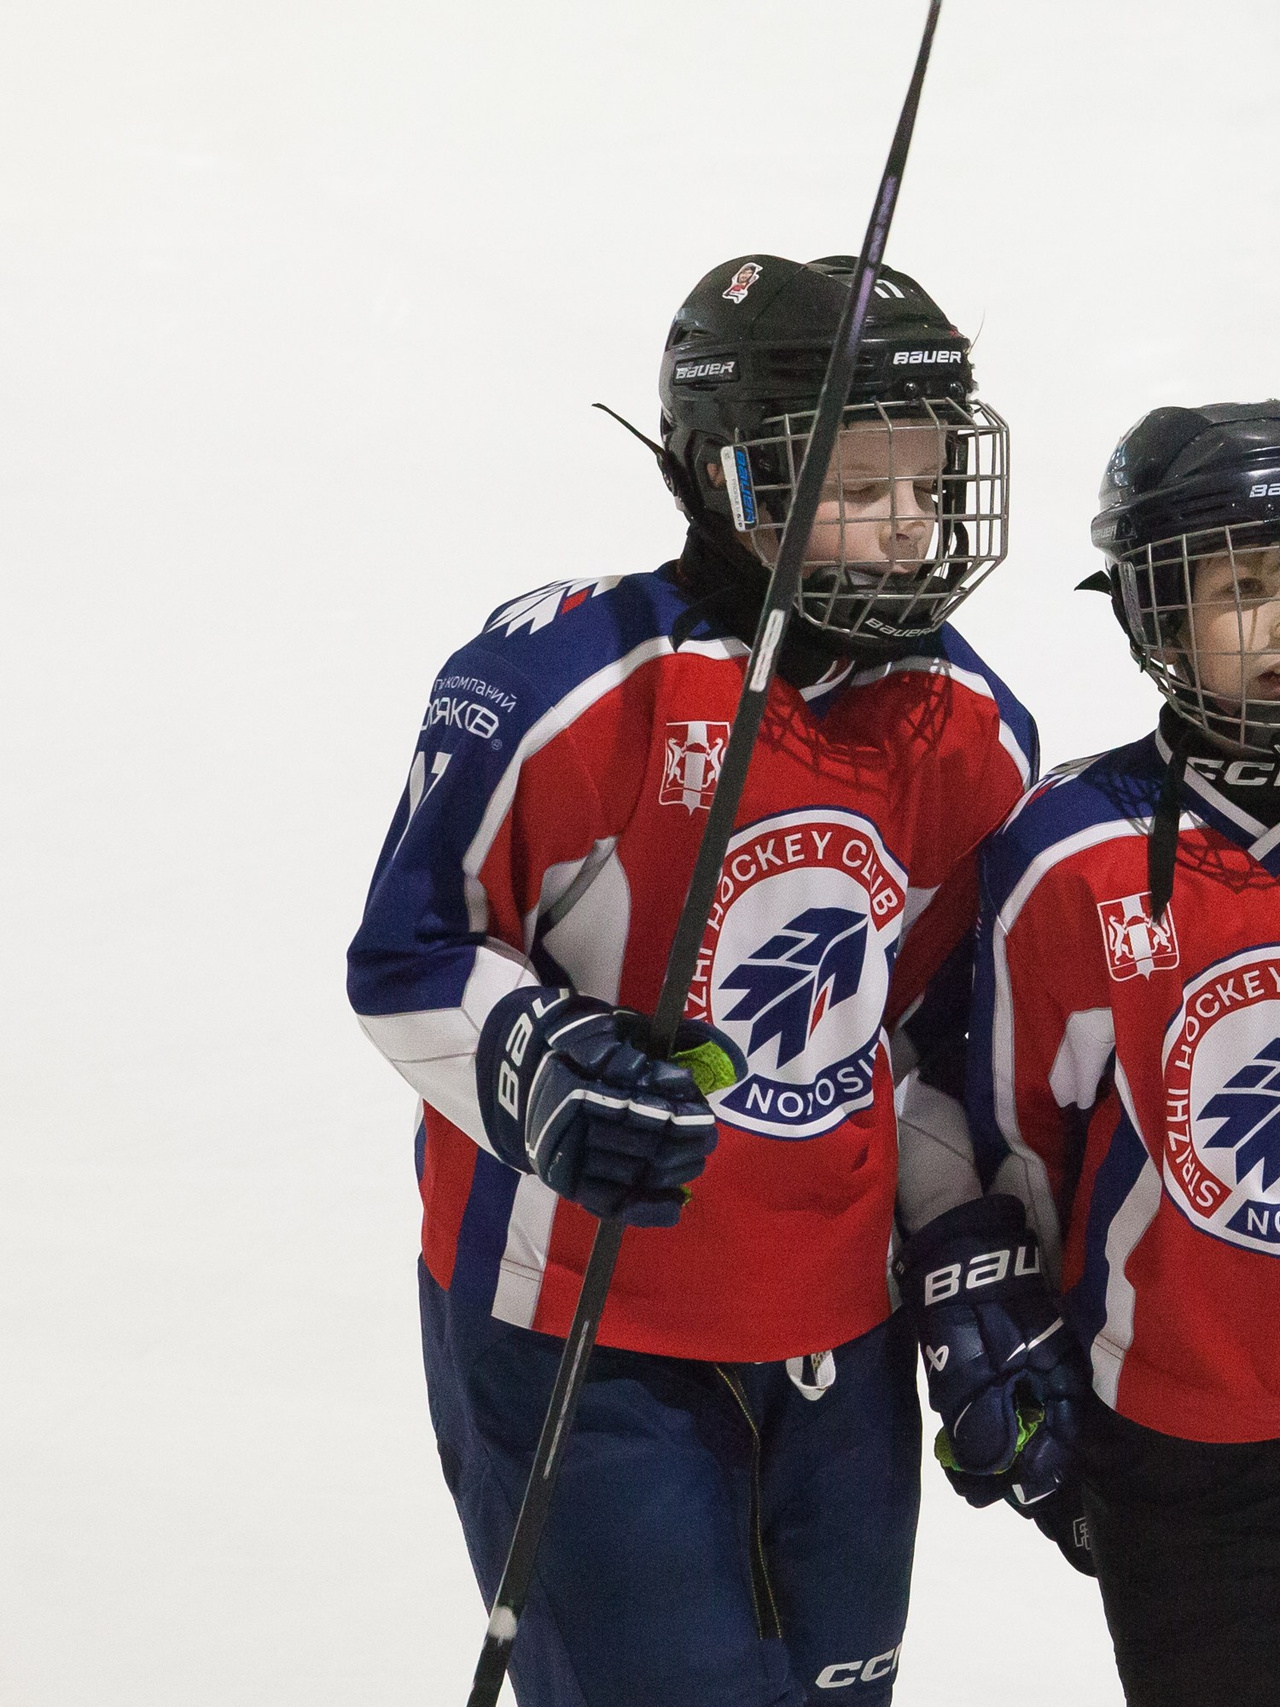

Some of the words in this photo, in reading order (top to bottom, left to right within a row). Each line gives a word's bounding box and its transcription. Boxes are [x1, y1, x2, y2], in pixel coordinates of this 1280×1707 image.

[675, 361, 736, 379] BAUER
[893, 350, 962, 365] BAUER
[707, 831, 833, 932] HOCKEY
[842, 839, 899, 916] CLUB
[1166, 1087, 1221, 1208] STRIZHI
